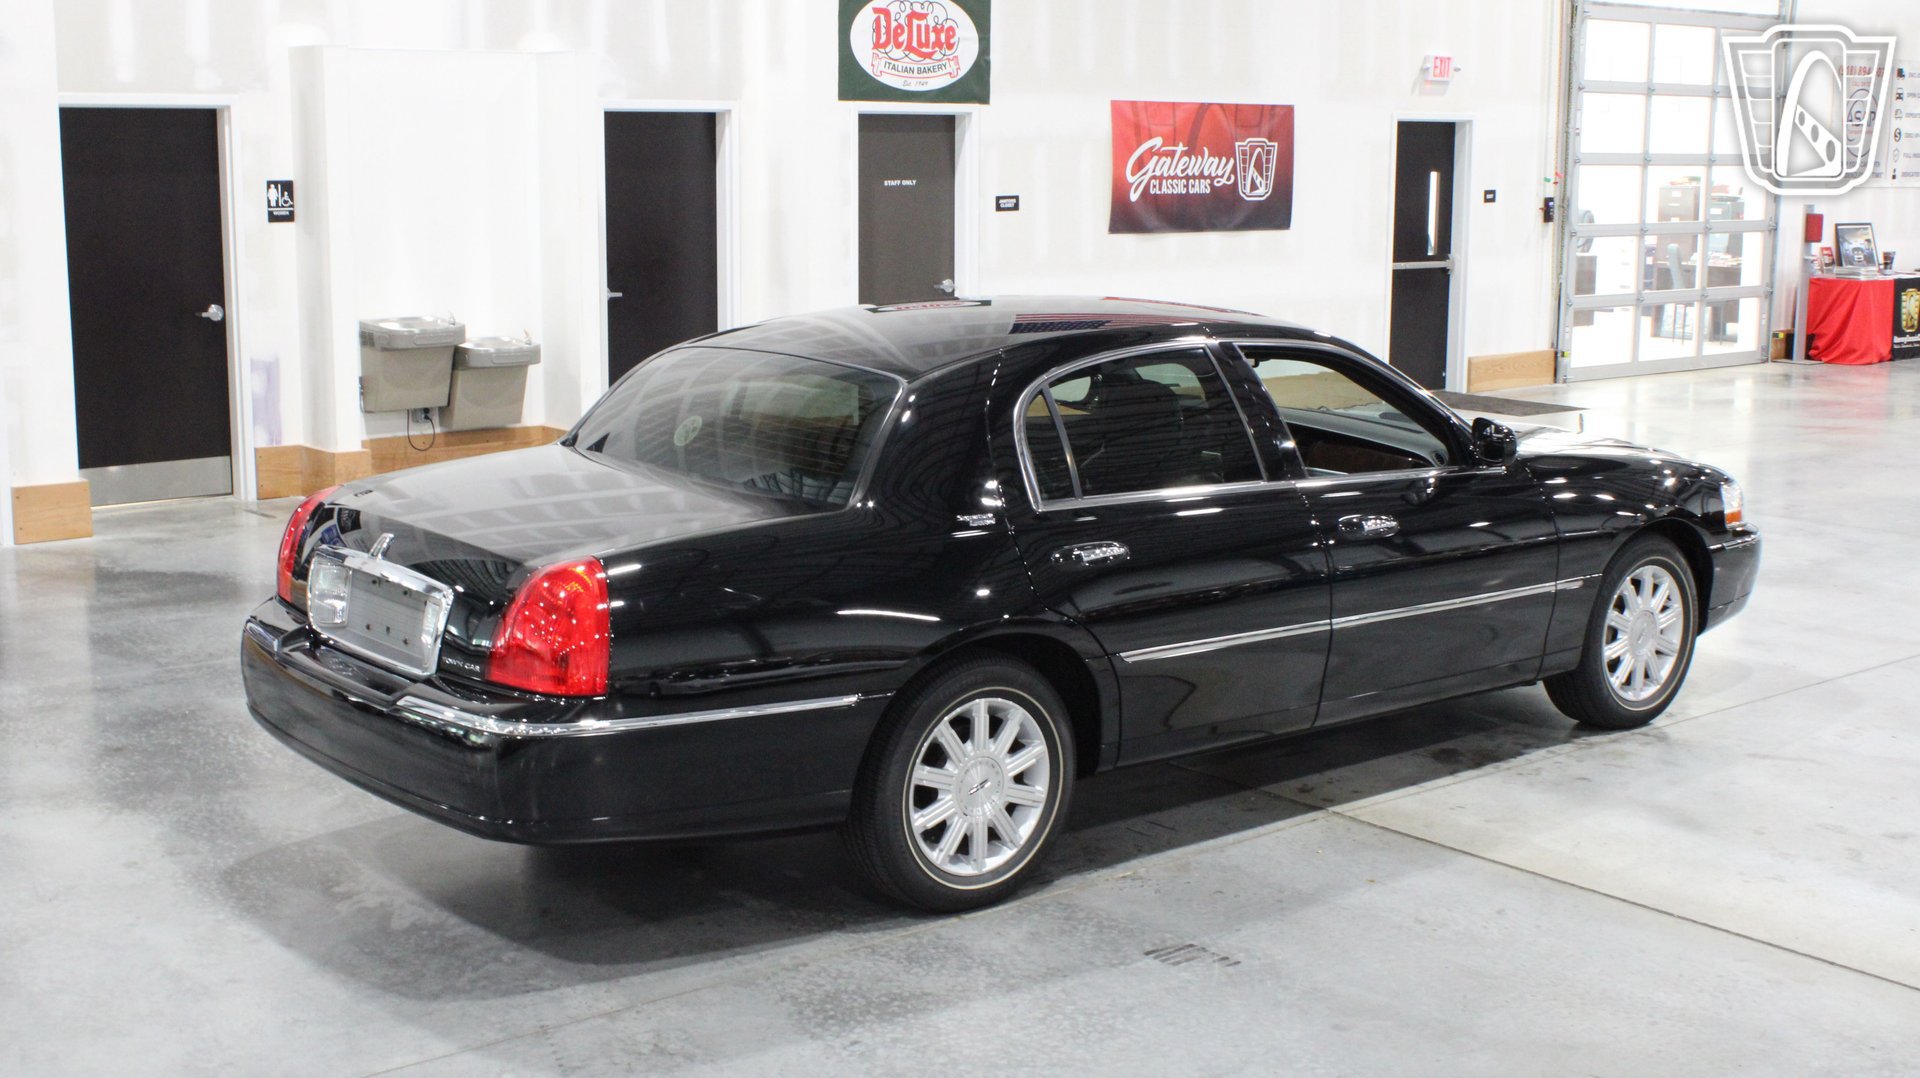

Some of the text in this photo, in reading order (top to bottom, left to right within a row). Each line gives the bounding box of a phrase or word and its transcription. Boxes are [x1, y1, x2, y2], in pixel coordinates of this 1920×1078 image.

[872, 7, 956, 59] DeLuxe
[883, 62, 948, 75] ITALIAN BAKERY
[1433, 56, 1452, 79] EXIT
[1126, 136, 1236, 202] Gateway
[883, 179, 901, 187] STAFF
[1149, 178, 1211, 195] CLASSIC CARS
[442, 656, 481, 673] TOWN CAR
